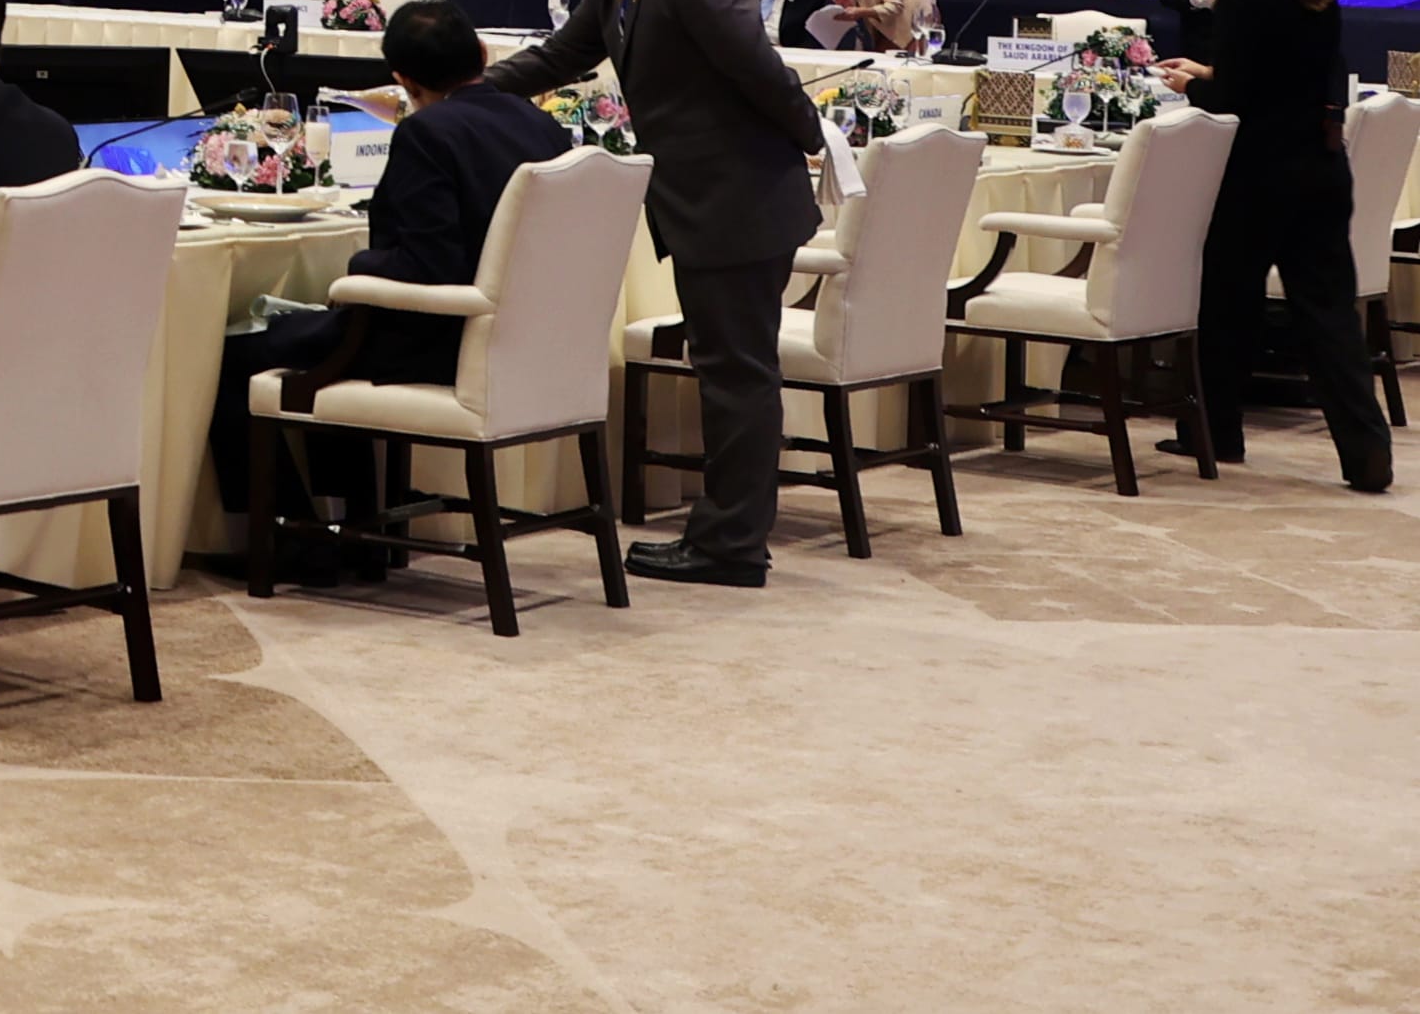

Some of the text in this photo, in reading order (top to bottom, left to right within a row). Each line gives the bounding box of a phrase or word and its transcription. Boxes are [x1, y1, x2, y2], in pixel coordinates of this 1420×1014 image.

[997, 42, 1068, 53] THE KINGDOM OF
[1003, 51, 1029, 60] SAUDI
[356, 143, 390, 157] INDONE
